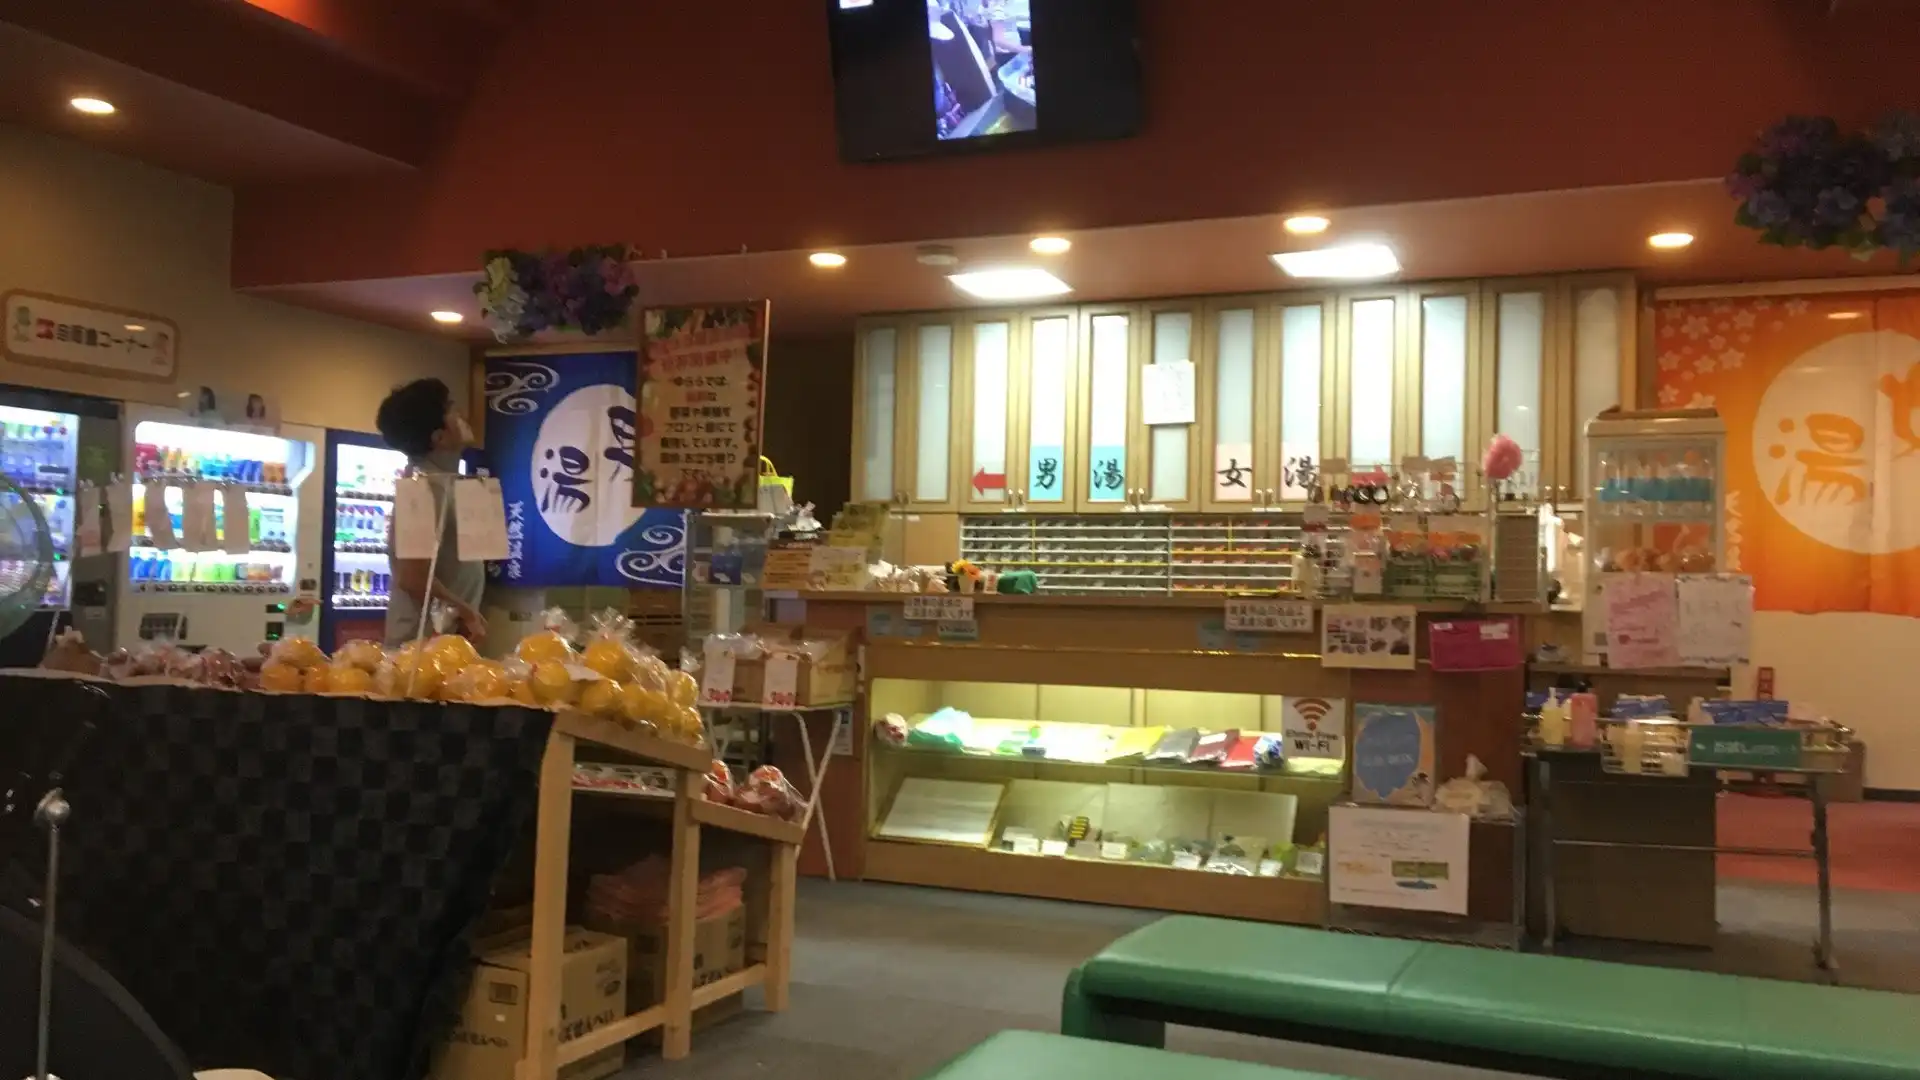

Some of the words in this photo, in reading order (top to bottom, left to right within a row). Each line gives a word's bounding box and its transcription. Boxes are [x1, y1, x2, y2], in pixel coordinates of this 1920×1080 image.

[1034, 458, 1058, 490] 男
[1092, 459, 1125, 491] 湯
[1217, 458, 1253, 488] 女
